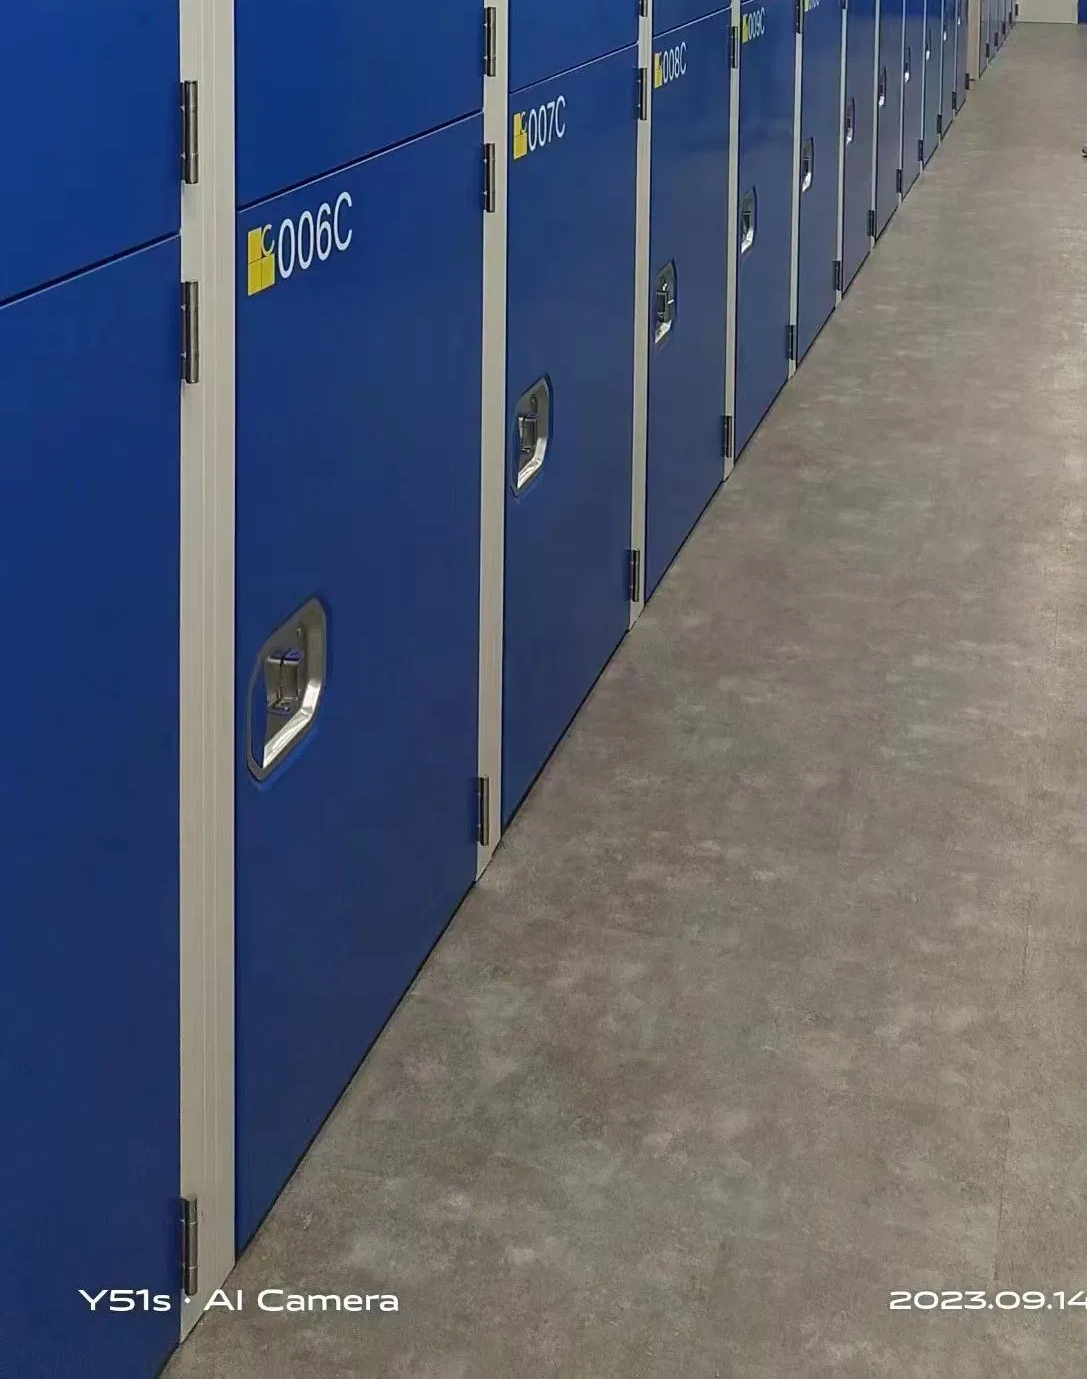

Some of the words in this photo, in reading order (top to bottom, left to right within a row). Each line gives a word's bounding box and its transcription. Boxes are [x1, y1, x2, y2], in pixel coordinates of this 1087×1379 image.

[663, 41, 687, 84] 008C
[528, 94, 566, 152] 007C
[277, 191, 353, 279] 006C
